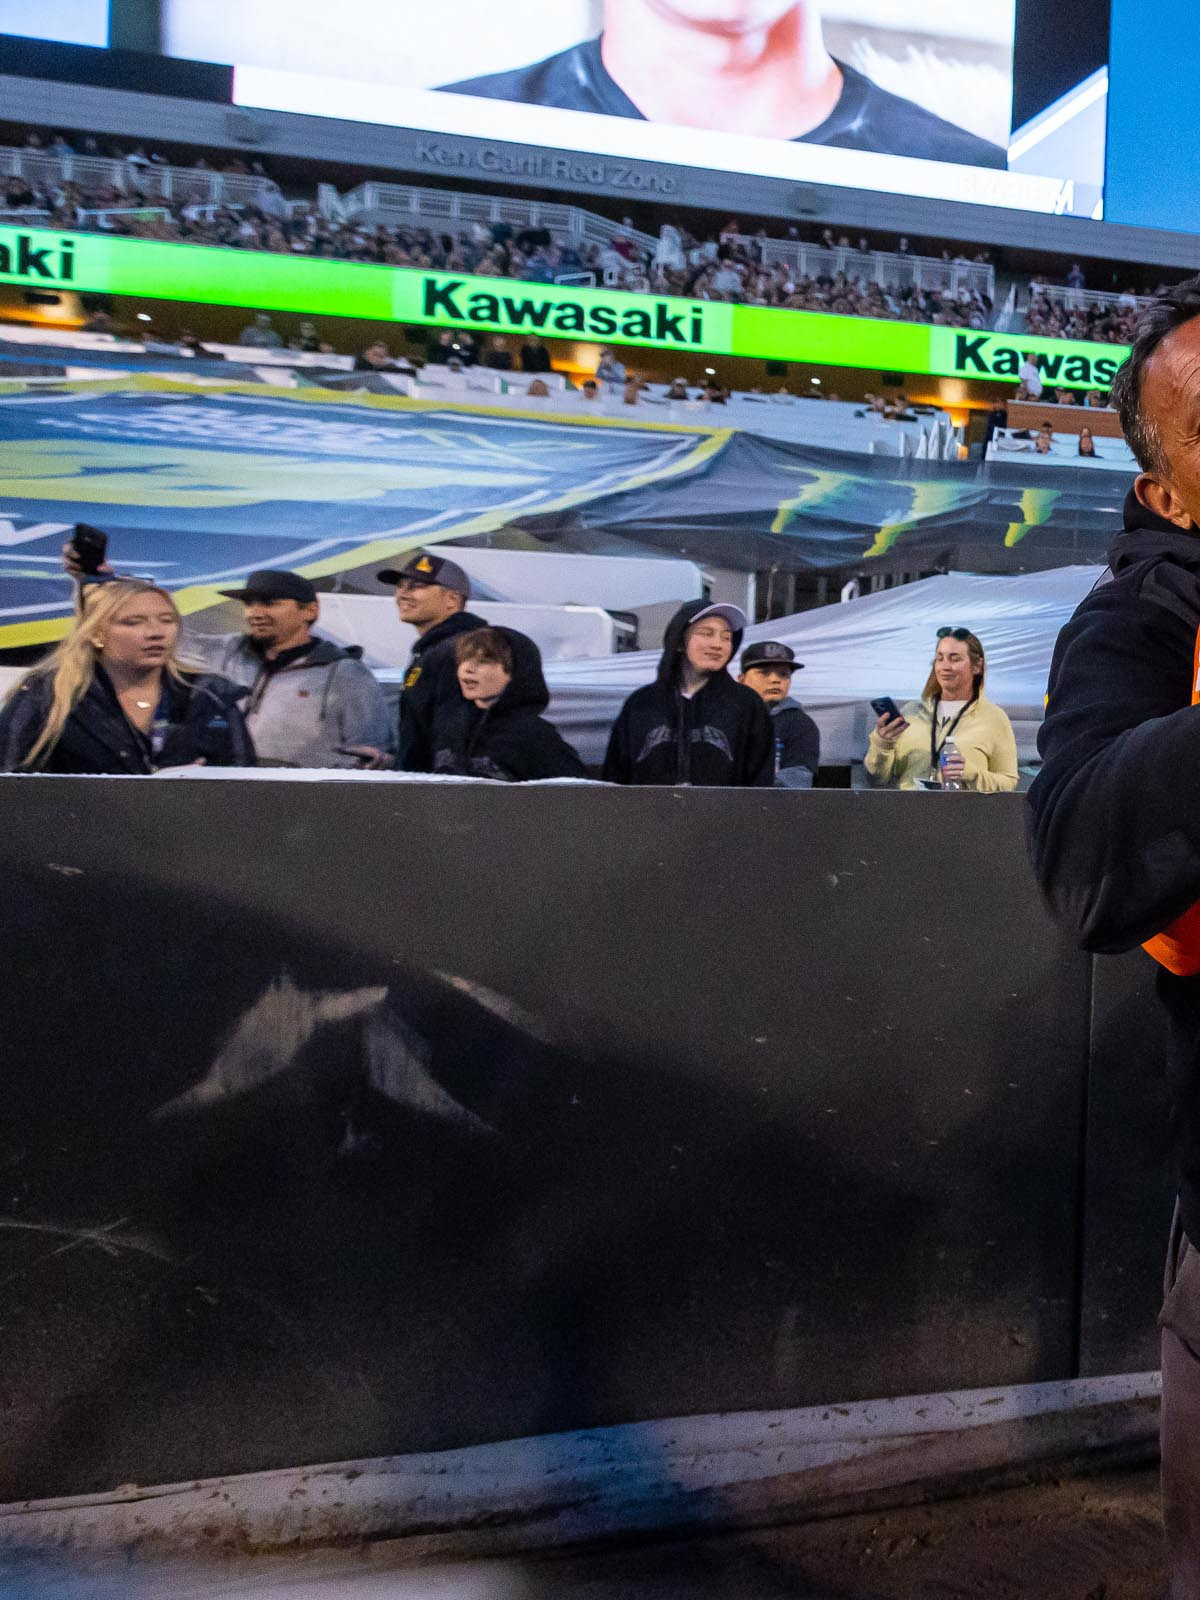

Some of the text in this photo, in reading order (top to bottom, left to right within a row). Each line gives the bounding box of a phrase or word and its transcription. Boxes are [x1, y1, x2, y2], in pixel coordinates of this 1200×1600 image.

[415, 141, 468, 168] Ken
[551, 156, 607, 184] Red
[611, 164, 679, 194] Zone
[422, 278, 704, 344] Kawasaki
